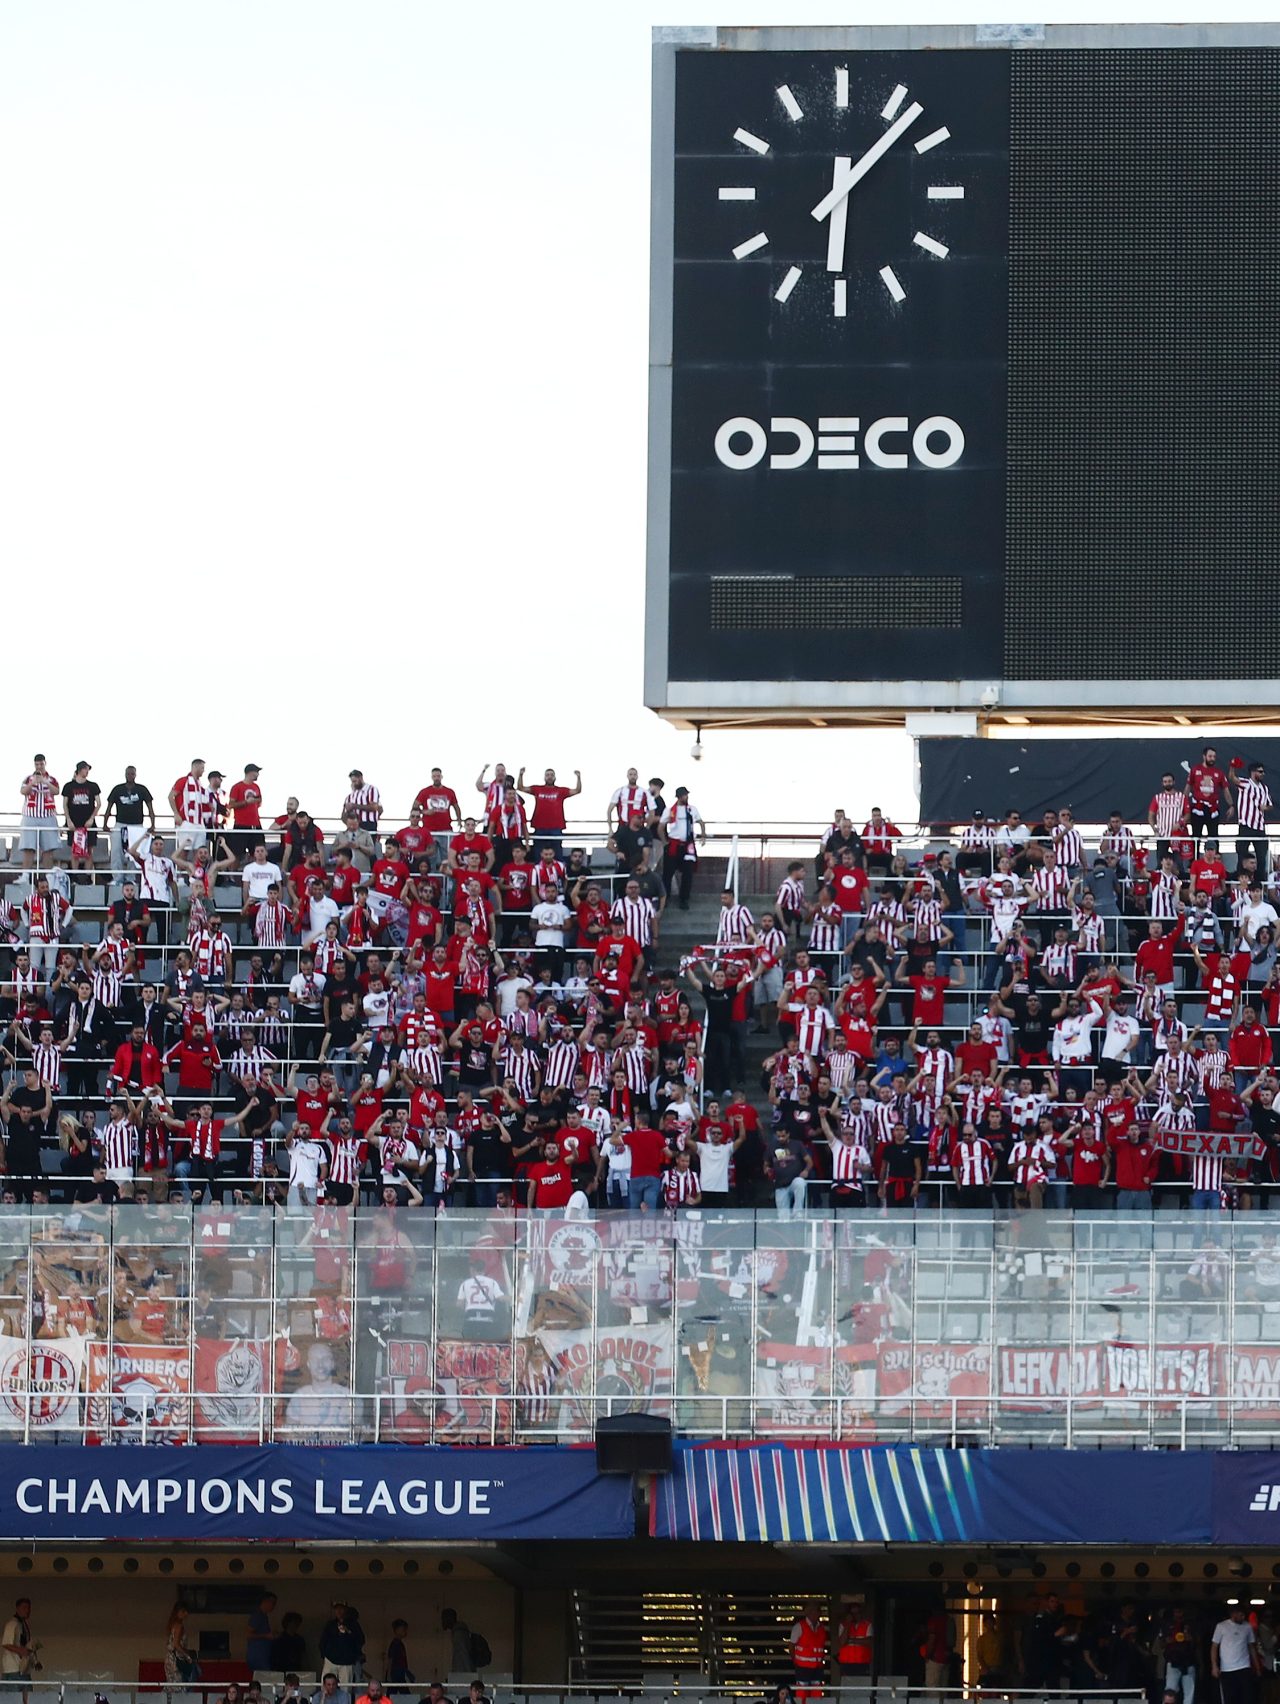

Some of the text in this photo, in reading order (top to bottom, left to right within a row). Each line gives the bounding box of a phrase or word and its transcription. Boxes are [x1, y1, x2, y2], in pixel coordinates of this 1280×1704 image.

[714, 415, 965, 470] ODECO
[94, 1353, 190, 1379] NÜRNBERG
[388, 1341, 429, 1377] RED
[1002, 1350, 1099, 1395] LEFKADA
[1107, 1346, 1211, 1395] VONITSA
[9, 1377, 68, 1393] HEROES
[814, 1408, 861, 1427] COST
[15, 1477, 294, 1514] CHAMPIONS
[314, 1479, 490, 1515] LEAGUE
